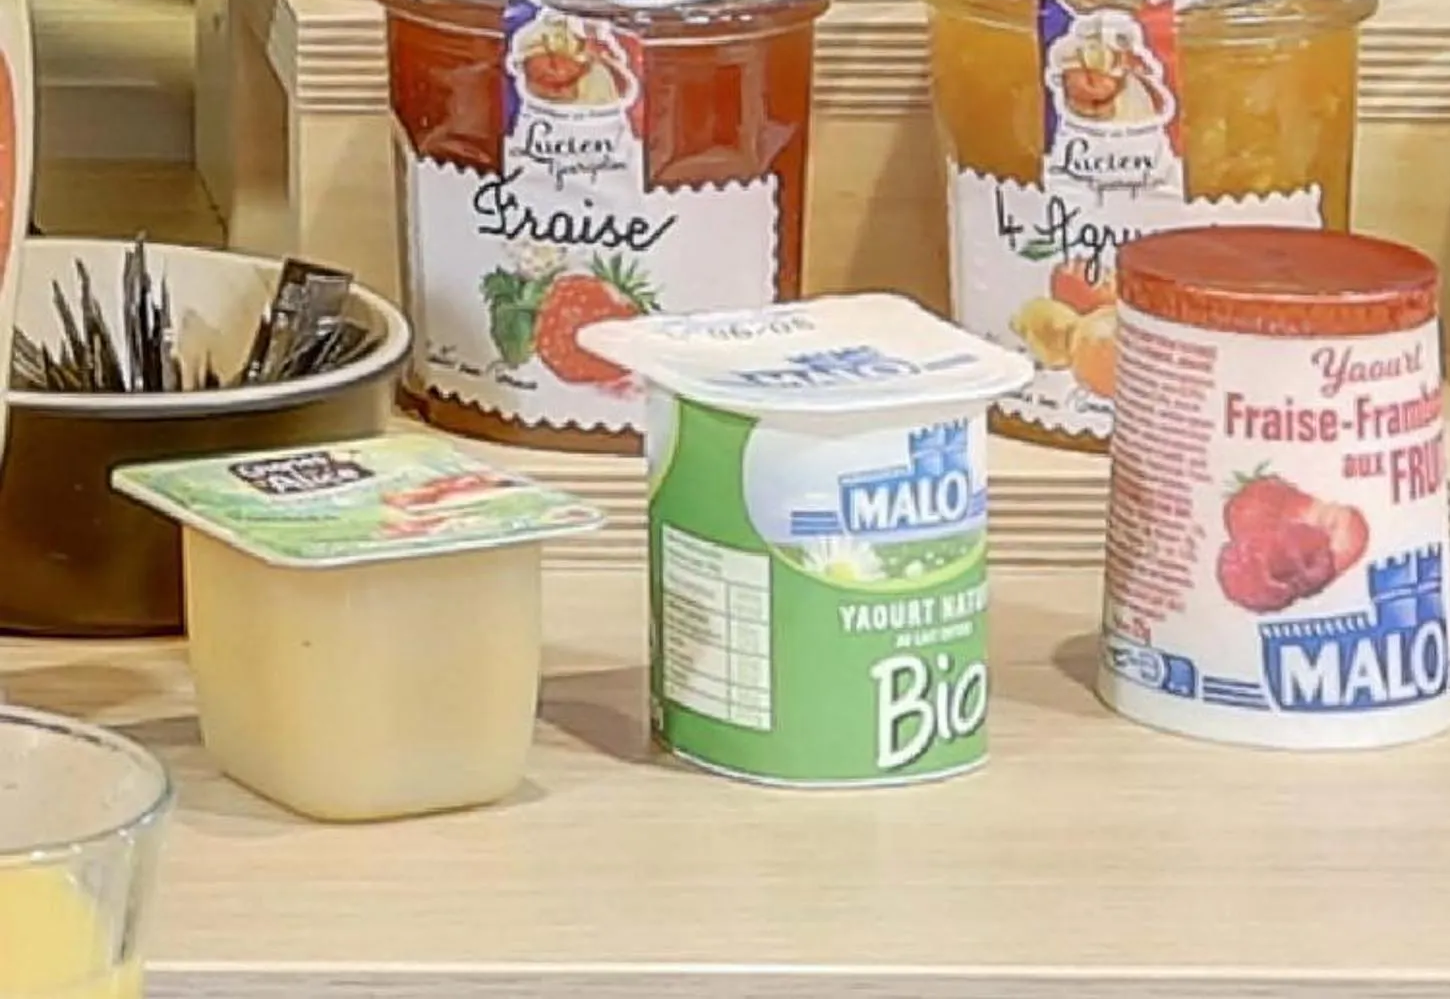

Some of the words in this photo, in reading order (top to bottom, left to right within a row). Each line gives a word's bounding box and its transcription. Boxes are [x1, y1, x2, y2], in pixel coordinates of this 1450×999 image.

[510, 119, 614, 163] Lucien
[1049, 137, 1153, 181] Lucien
[473, 166, 678, 250] Fraise
[996, 181, 1023, 251] 4
[1033, 195, 1143, 286] Agru
[1311, 342, 1425, 398] Yaourt
[848, 473, 968, 531] MALO
[1342, 451, 1386, 478] aux
[1389, 435, 1444, 505] FRU
[838, 598, 936, 632] YAOURT
[1279, 620, 1447, 708] MALO
[869, 653, 987, 770] Bio
